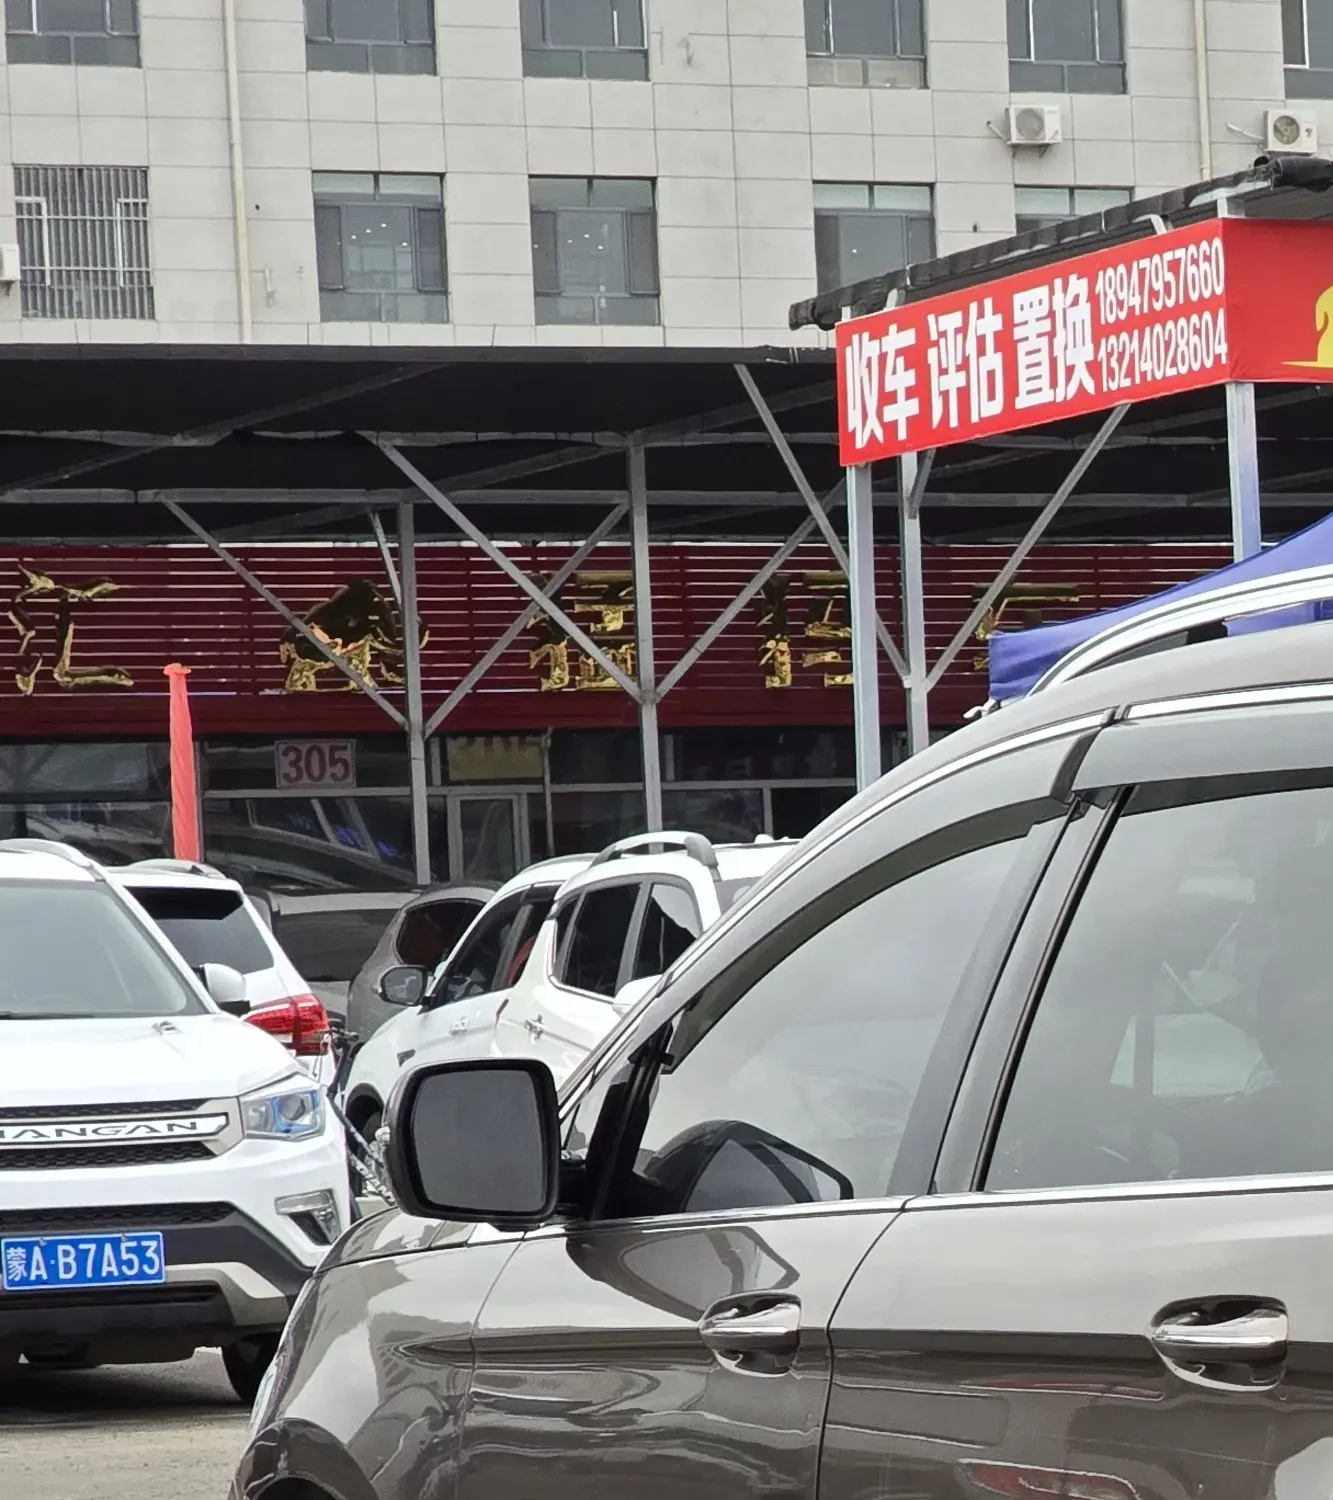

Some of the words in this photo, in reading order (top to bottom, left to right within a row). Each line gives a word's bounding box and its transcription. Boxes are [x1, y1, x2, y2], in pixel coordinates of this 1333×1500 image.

[1095, 236, 1225, 326] 18947957660
[845, 322, 920, 449] 收车
[927, 297, 1003, 430] 评估
[1012, 273, 1096, 411] 置换
[1097, 307, 1228, 393] 13214028604
[281, 744, 351, 784] 305
[0, 1121, 198, 1140] ANGAN
